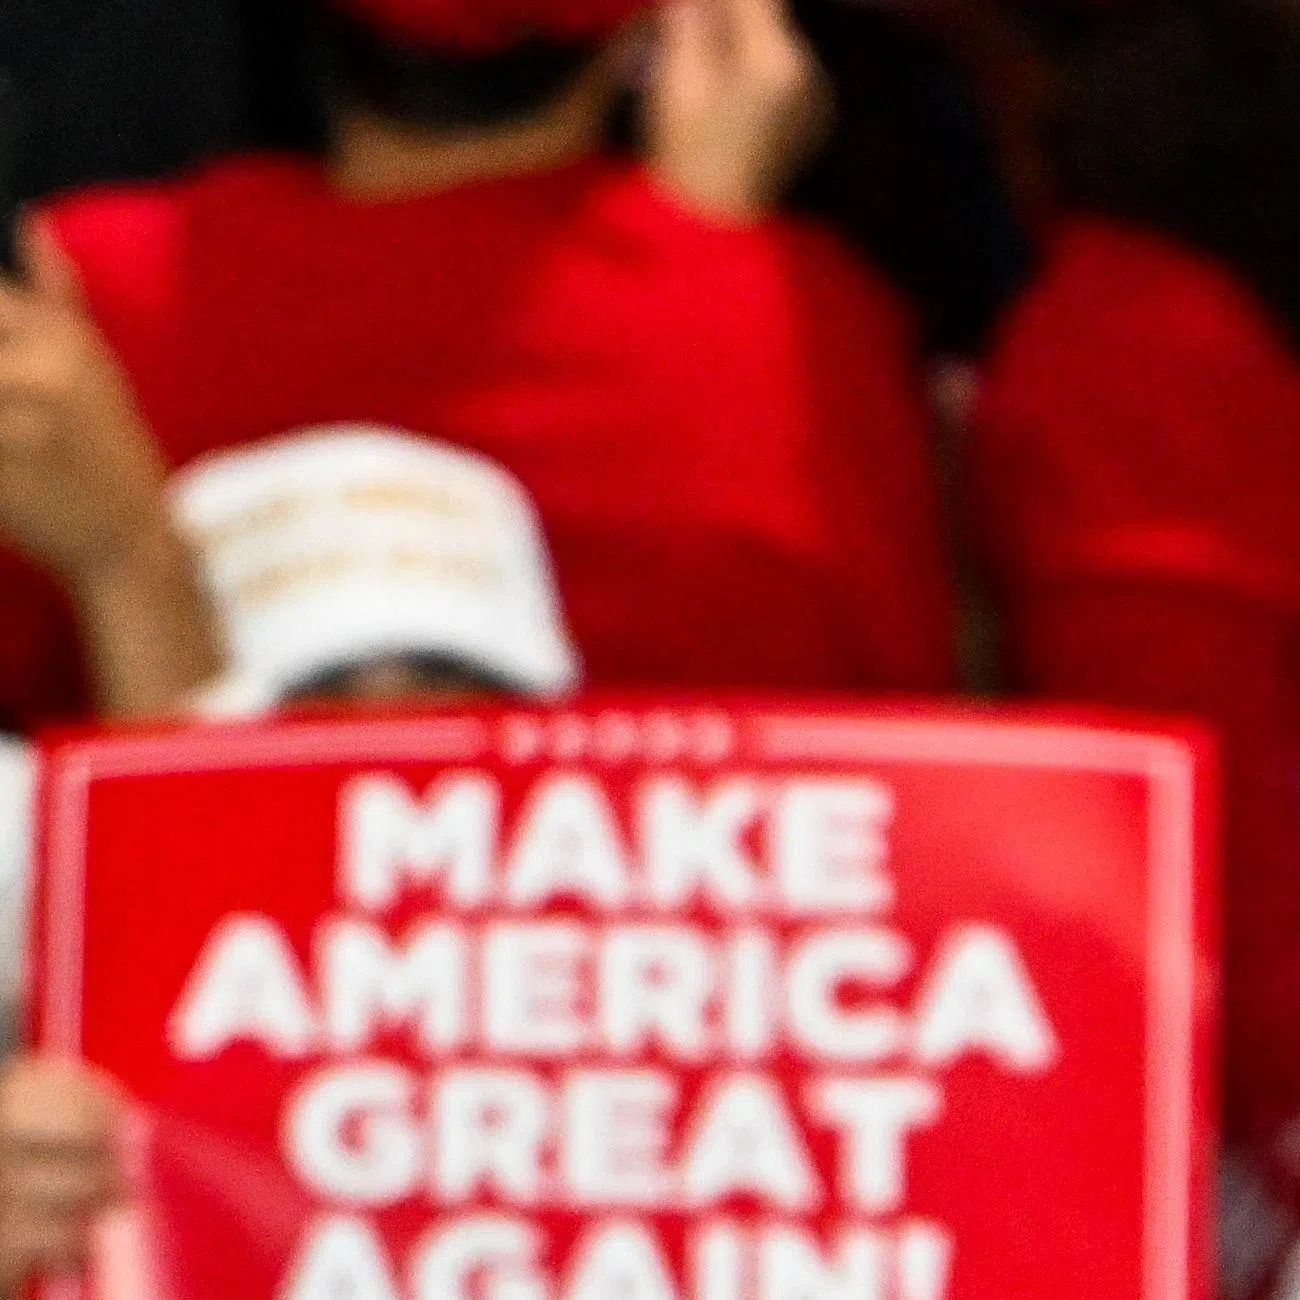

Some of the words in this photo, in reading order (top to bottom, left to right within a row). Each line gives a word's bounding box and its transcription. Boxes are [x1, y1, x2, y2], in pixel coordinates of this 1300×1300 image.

[338, 770, 897, 914] MAKE
[170, 912, 1058, 1074] AMERICA
[280, 1063, 946, 1213] GREAT
